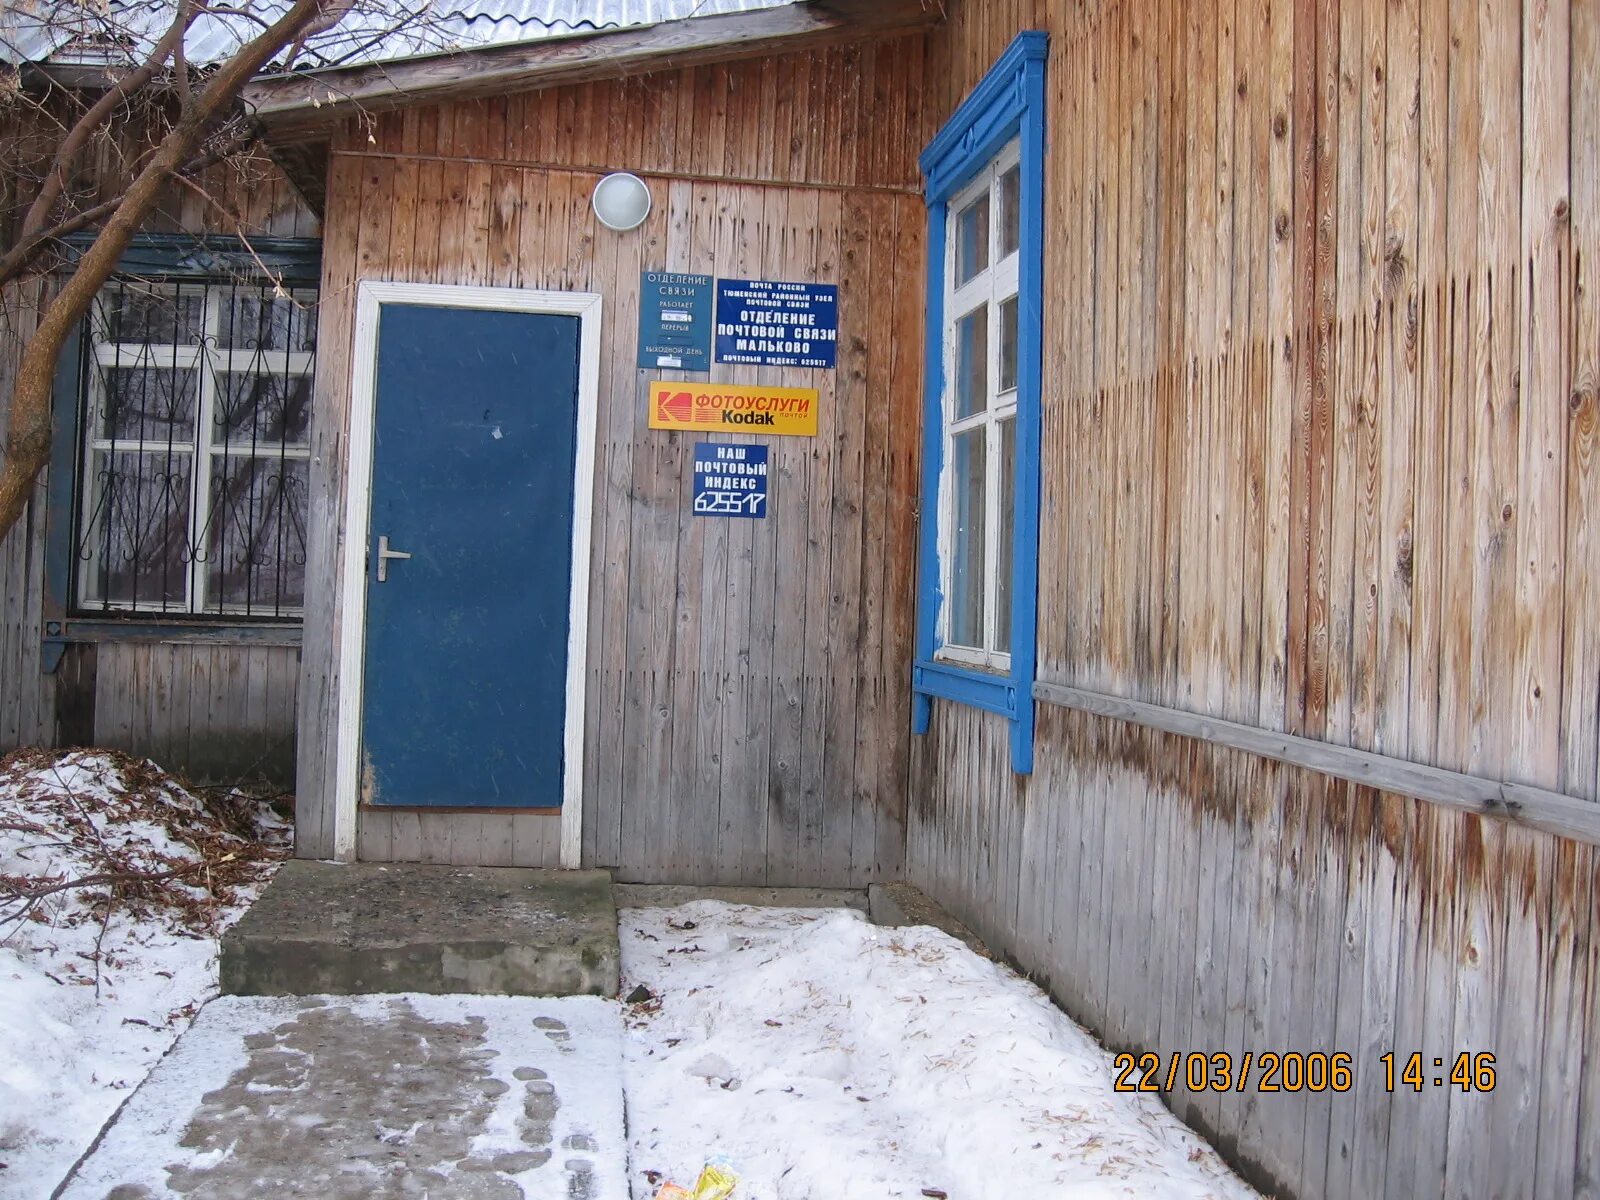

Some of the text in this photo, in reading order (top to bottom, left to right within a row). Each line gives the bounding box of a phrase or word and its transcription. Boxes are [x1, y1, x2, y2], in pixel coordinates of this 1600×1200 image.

[648, 273, 708, 286] ОТДЕЛЕНИЕ
[749, 281, 806, 291] ПОЧТА РОССИИ
[659, 286, 695, 297] СВЯЗИ
[659, 300, 694, 309] РАБОТАЕТ
[746, 298, 810, 309] ПОЧТОВОЙ СВЯЗИ
[740, 310, 816, 326] ОТДЕЛЕНИЕ
[661, 323, 689, 332] ПЕРЕРЫВ
[717, 323, 836, 341] ПОЧТОВОЙ СВЯЗИ
[645, 345, 703, 356] ВЫХОДНОЙ ДЕНЬ
[736, 338, 811, 354] МАЛЬКОВО
[722, 354, 762, 363] ПОЧТОВЫЙ
[695, 393, 810, 413] ФОТОУСЛУГИ
[721, 409, 775, 426] Kodak
[717, 446, 746, 460] НАШ
[695, 460, 767, 476] ПОЧТОВЫЙ
[704, 475, 757, 490] ИНДЕКС
[694, 491, 766, 514] 625517
